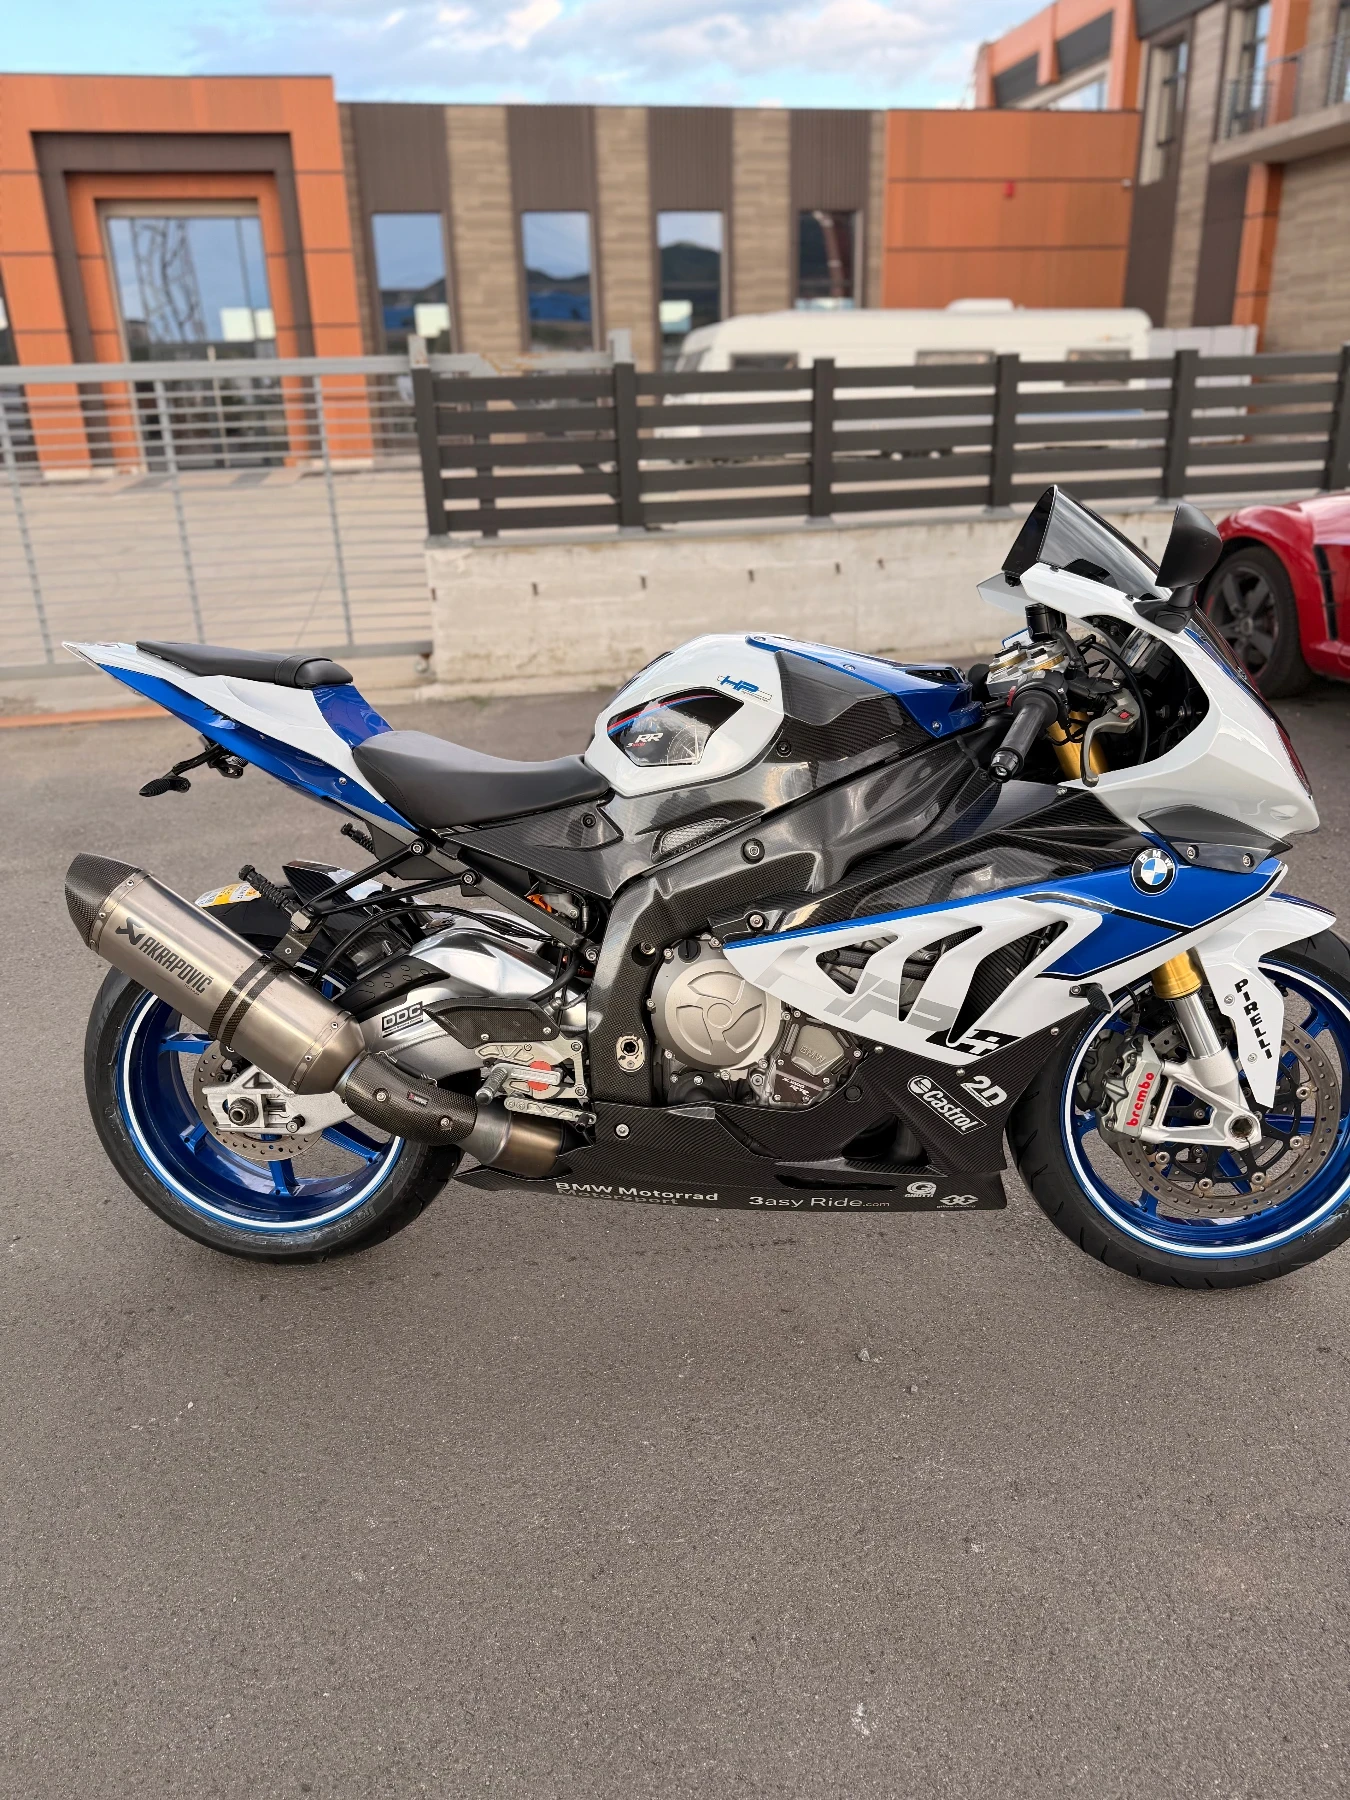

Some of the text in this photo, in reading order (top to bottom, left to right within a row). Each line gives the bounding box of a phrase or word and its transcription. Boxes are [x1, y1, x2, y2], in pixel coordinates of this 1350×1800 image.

[634, 732, 664, 744] RR
[138, 936, 214, 994] AKRAPOVIČ
[383, 1004, 421, 1029] DDC
[1234, 978, 1273, 1060] PIRELLI
[922, 1089, 979, 1131] Castrol
[1126, 1072, 1155, 1127] brembo
[555, 1182, 719, 1201] BMW Motorrad
[557, 1188, 679, 1205] Motorsport
[748, 1196, 804, 1208] 3asy
